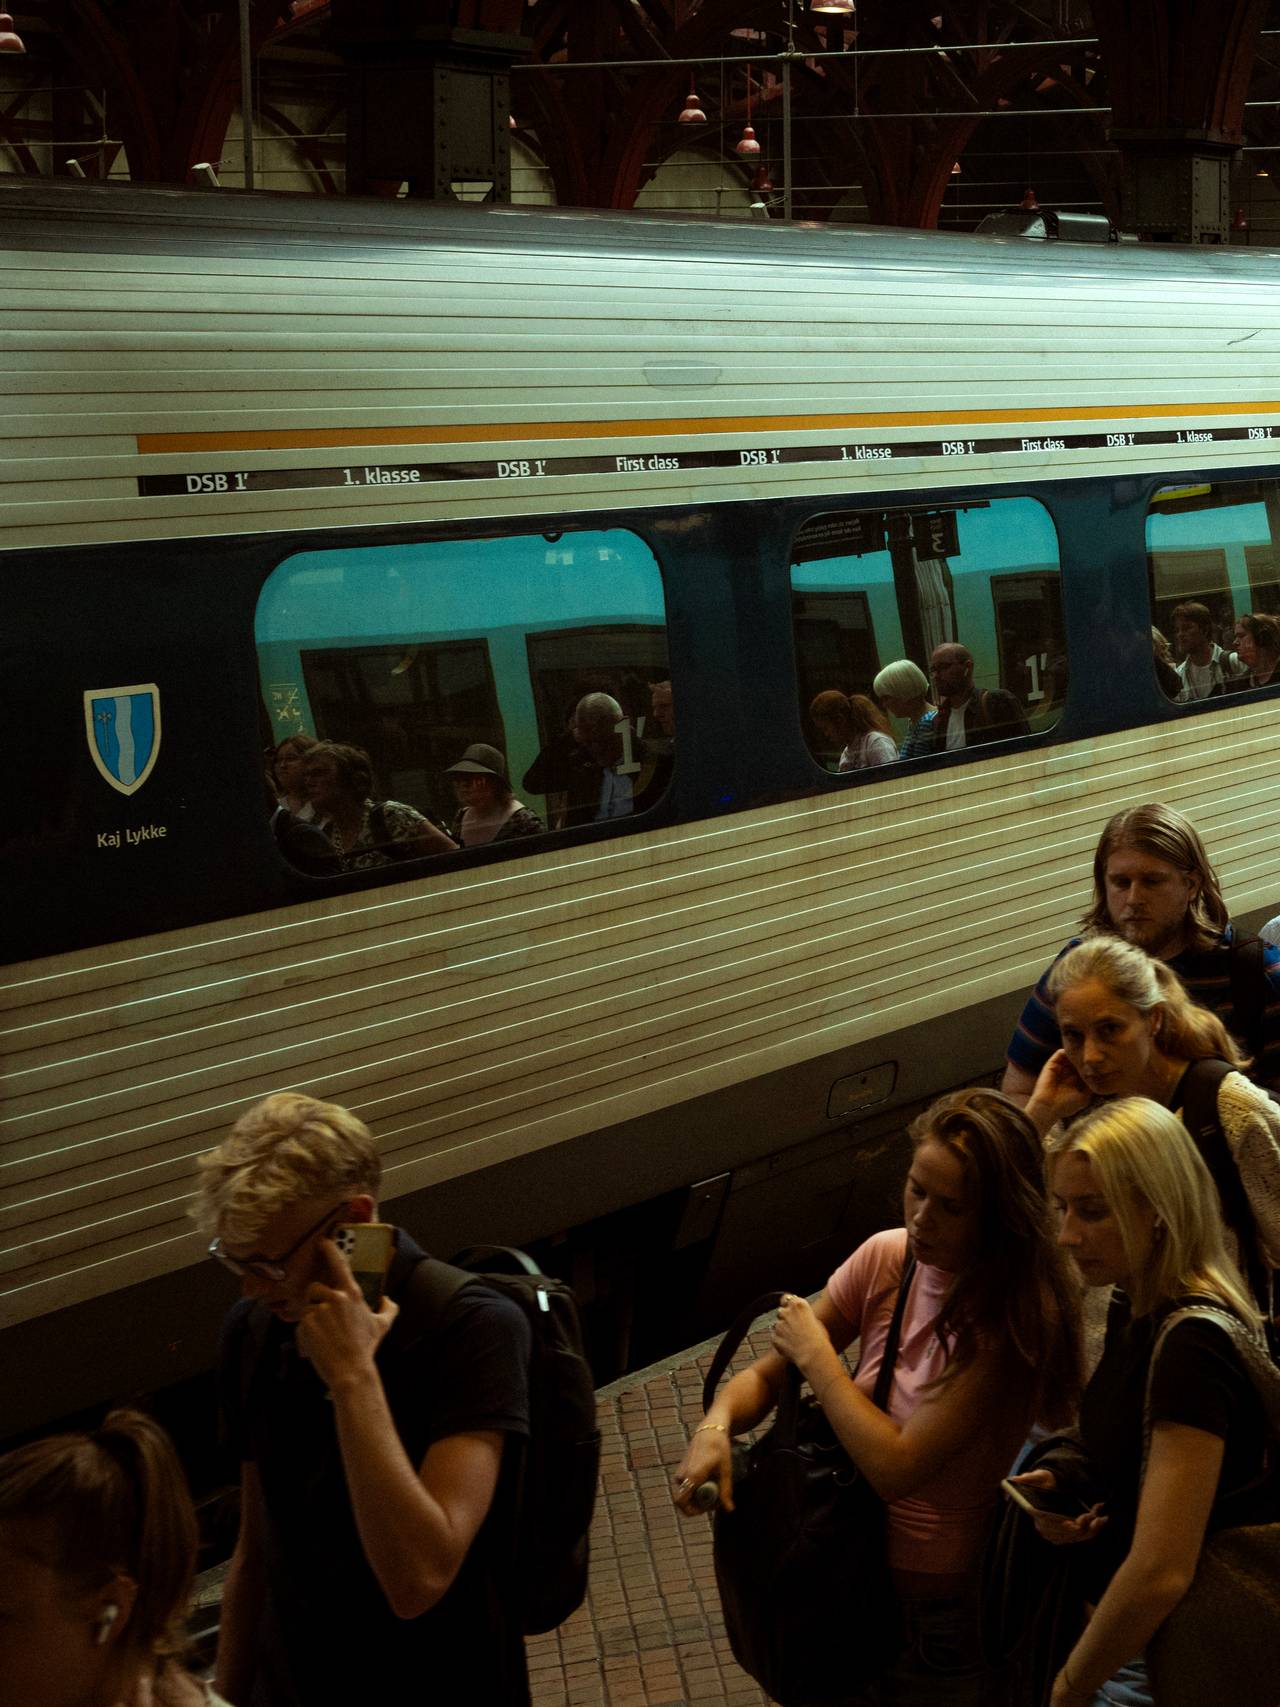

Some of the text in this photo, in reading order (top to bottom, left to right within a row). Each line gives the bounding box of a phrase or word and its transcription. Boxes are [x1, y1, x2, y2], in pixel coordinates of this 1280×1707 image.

[186, 474, 228, 493] DSB
[343, 469, 360, 486] 1.
[364, 466, 421, 484] klasse
[497, 461, 531, 477] DSB
[615, 456, 646, 472] First
[647, 454, 680, 471] class
[740, 450, 767, 465] DSB
[840, 447, 853, 460] 1.
[855, 445, 892, 460] klasse
[942, 442, 965, 455] DSB
[1021, 439, 1042, 452] First
[1043, 437, 1065, 451] class
[1106, 434, 1126, 447] DSB
[1176, 431, 1186, 444] 1.
[1186, 430, 1213, 443] klasse
[1247, 427, 1265, 439] DSB
[97, 824, 167, 848] Kaj Lykke
